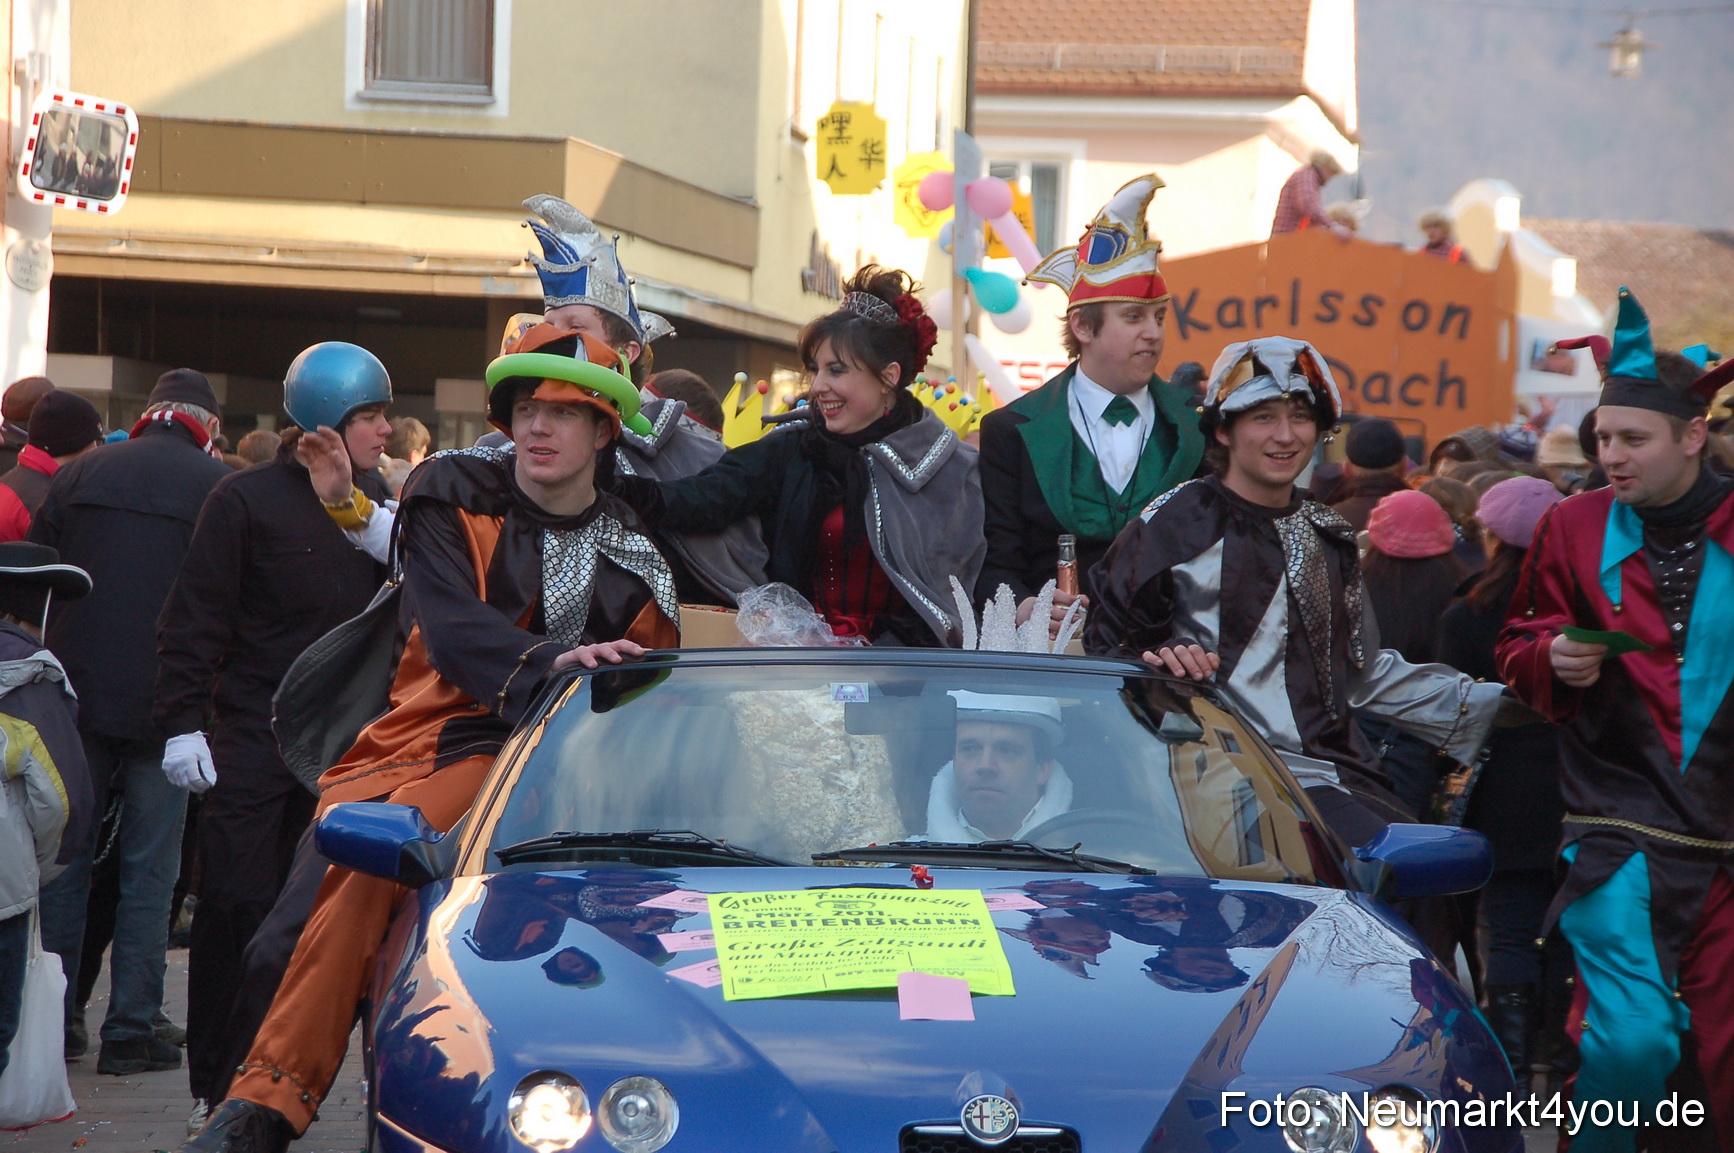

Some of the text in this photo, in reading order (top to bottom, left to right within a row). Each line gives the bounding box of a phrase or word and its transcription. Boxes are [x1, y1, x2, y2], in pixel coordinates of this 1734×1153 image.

[1171, 278, 1471, 340] Karlsson
[718, 894, 797, 909] Großer
[723, 918, 980, 929] BREITENBRUNN
[728, 939, 825, 951] Große
[835, 937, 988, 948] Zeltgaudi
[965, 1097, 1016, 1120] ALFA ROMEO
